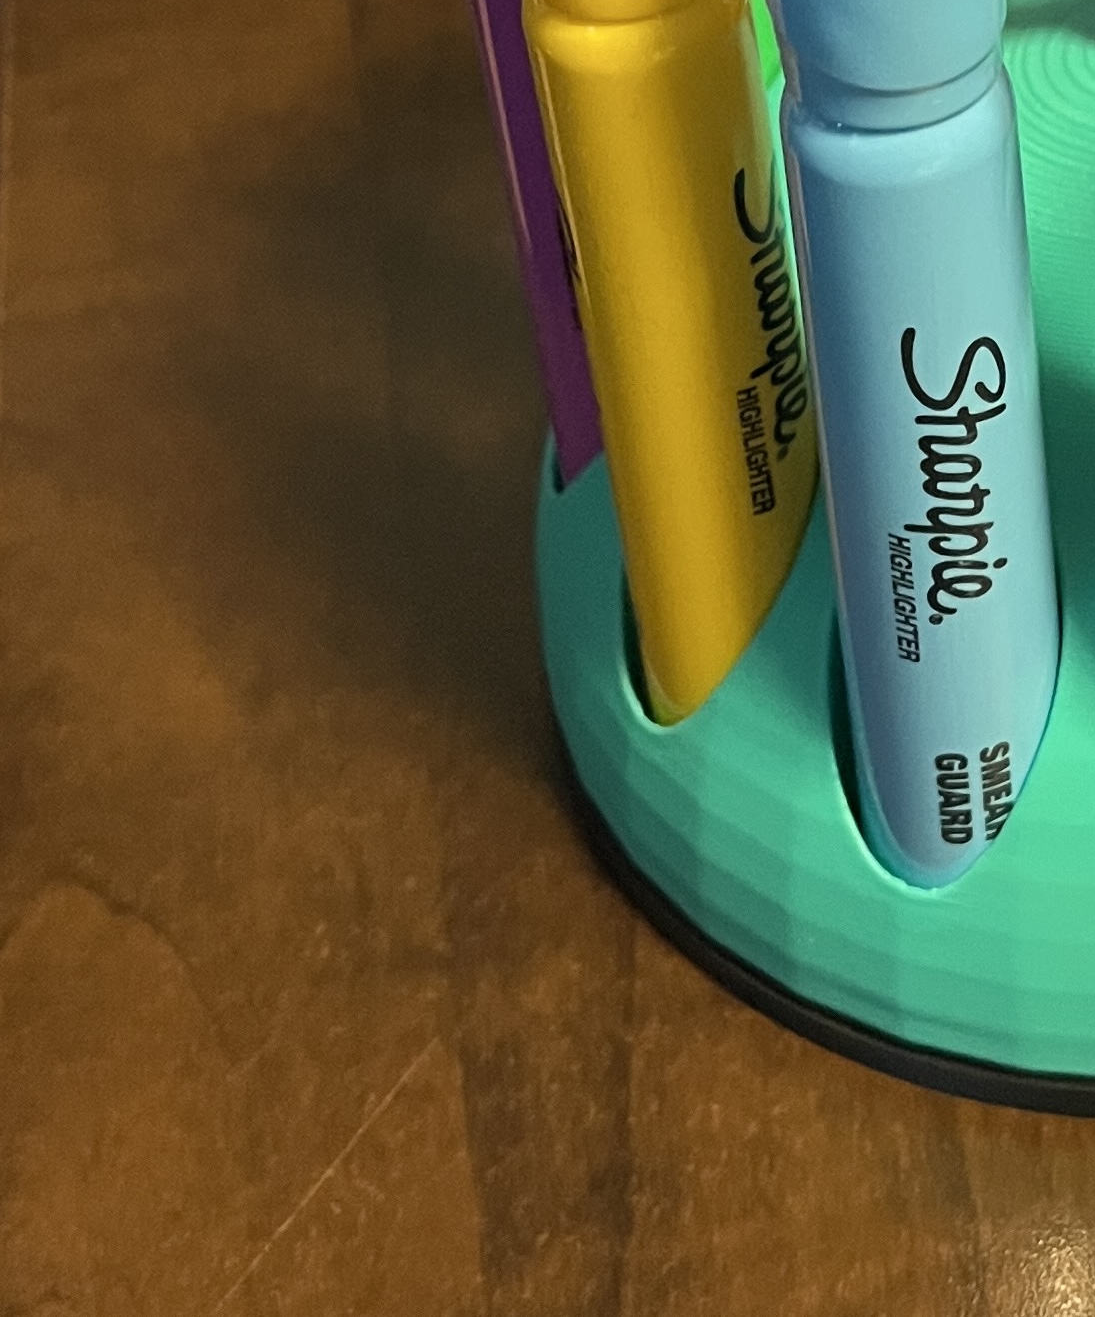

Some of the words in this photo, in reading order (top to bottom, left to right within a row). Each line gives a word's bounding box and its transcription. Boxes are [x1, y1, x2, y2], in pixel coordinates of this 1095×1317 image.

[736, 385, 777, 516] HIGHLIGHTER
[901, 327, 1007, 616] Sharpie
[888, 533, 922, 663] HIGHLIGHTER
[934, 753, 974, 844] GUARD
